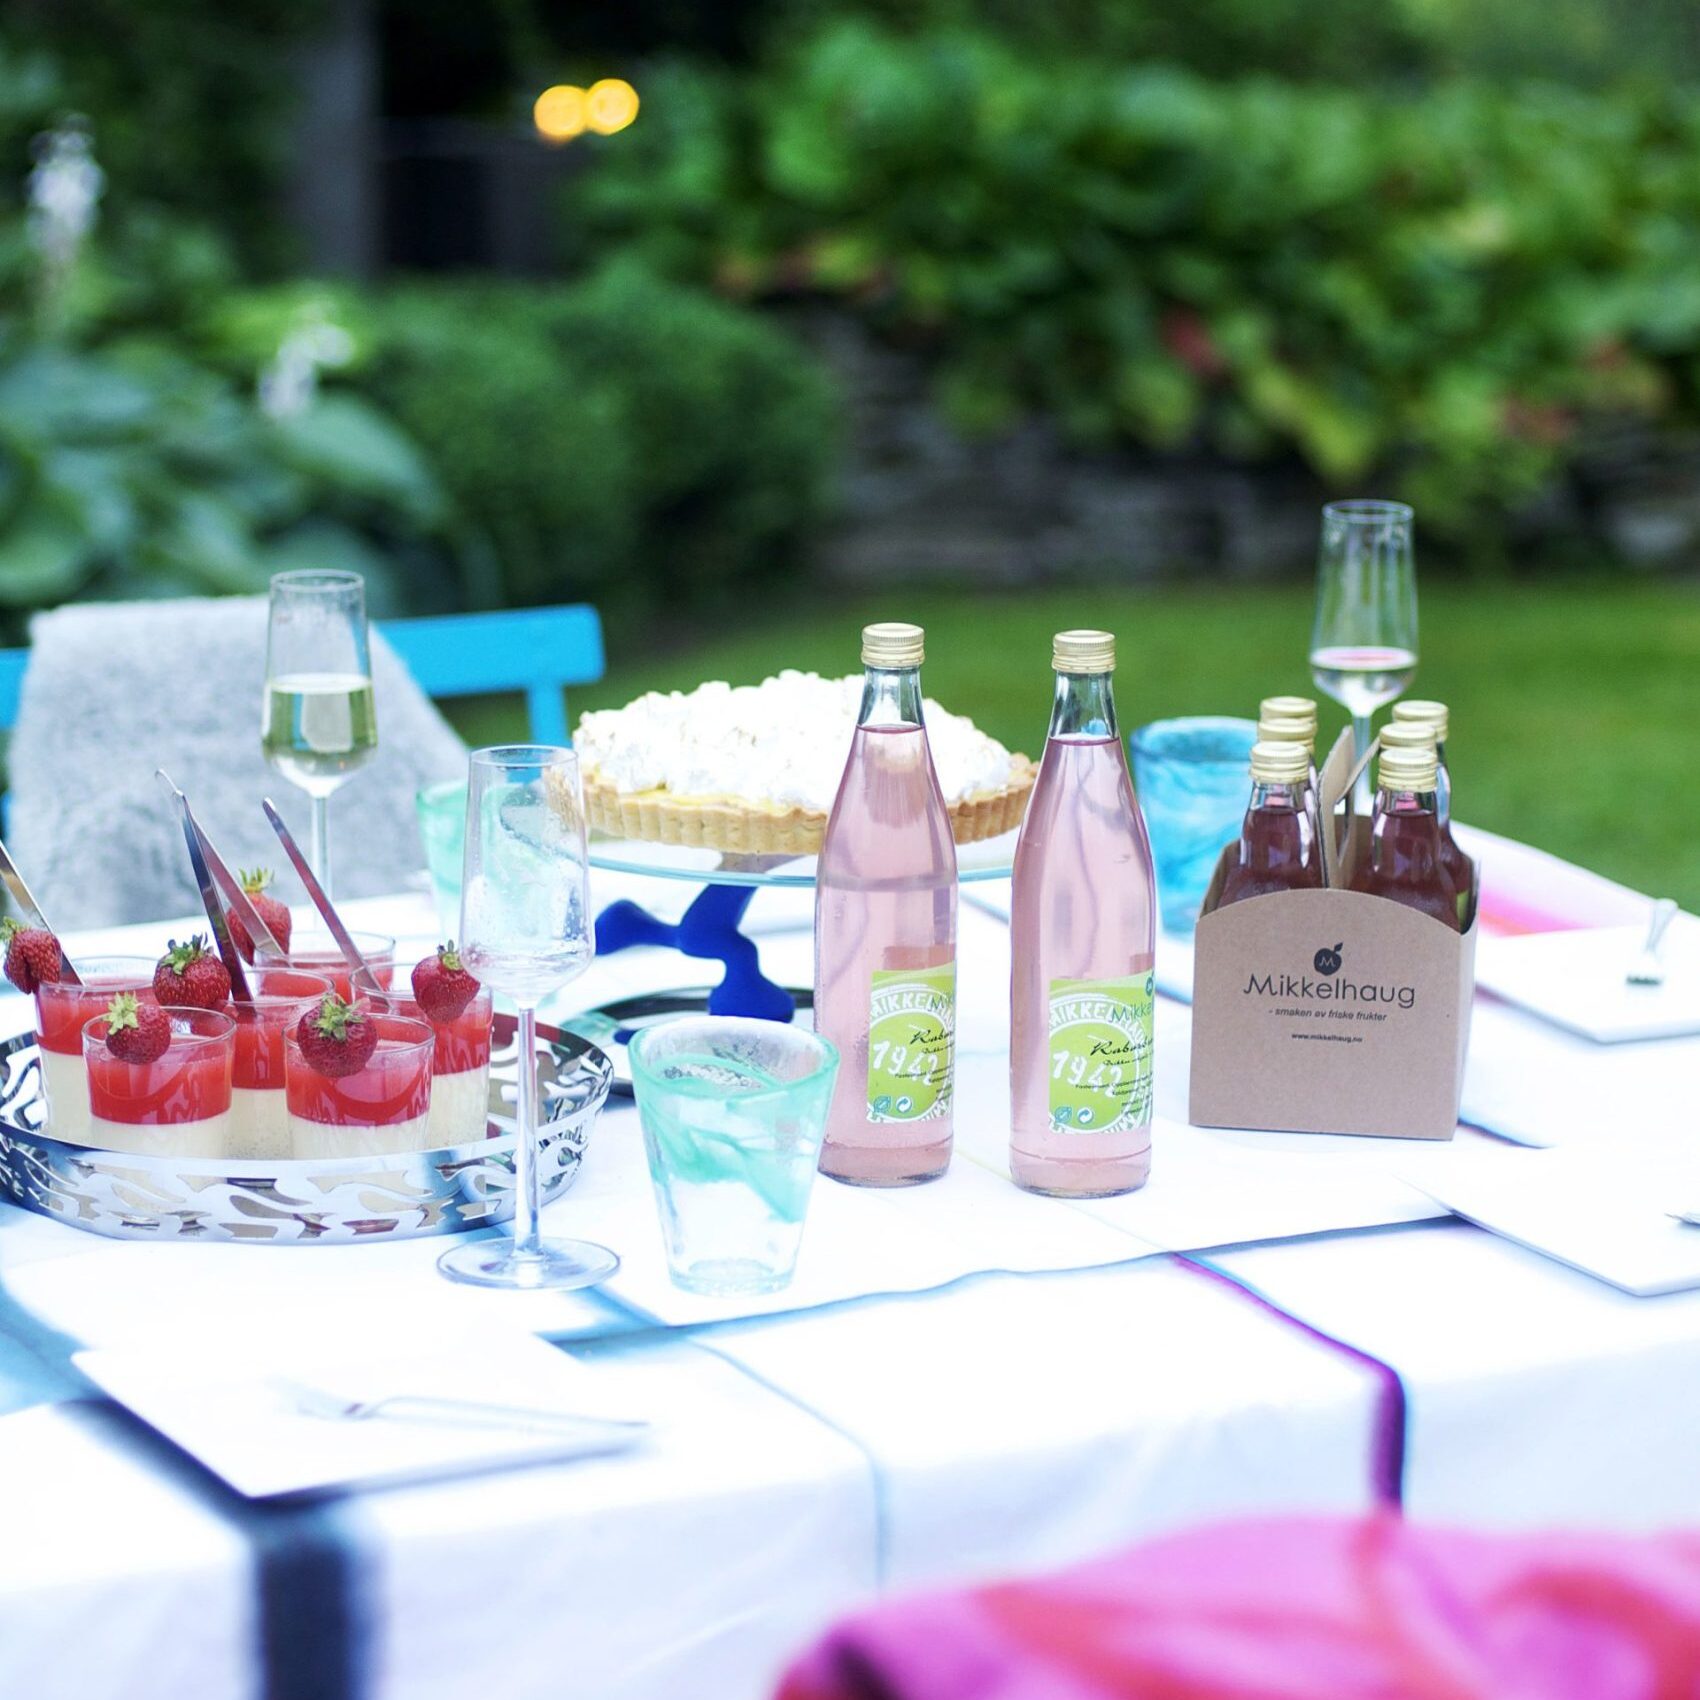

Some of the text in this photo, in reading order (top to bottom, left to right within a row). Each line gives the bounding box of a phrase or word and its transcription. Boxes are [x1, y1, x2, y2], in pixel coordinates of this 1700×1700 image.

[1319, 956, 1336, 968] M
[1243, 973, 1416, 1009] Mikkelhaug
[1274, 1008, 1312, 1018] smaken
[1327, 1009, 1355, 1020] friske
[1356, 1011, 1388, 1022] frukter
[1291, 1032, 1363, 1044] www.mikkelhaug.no
